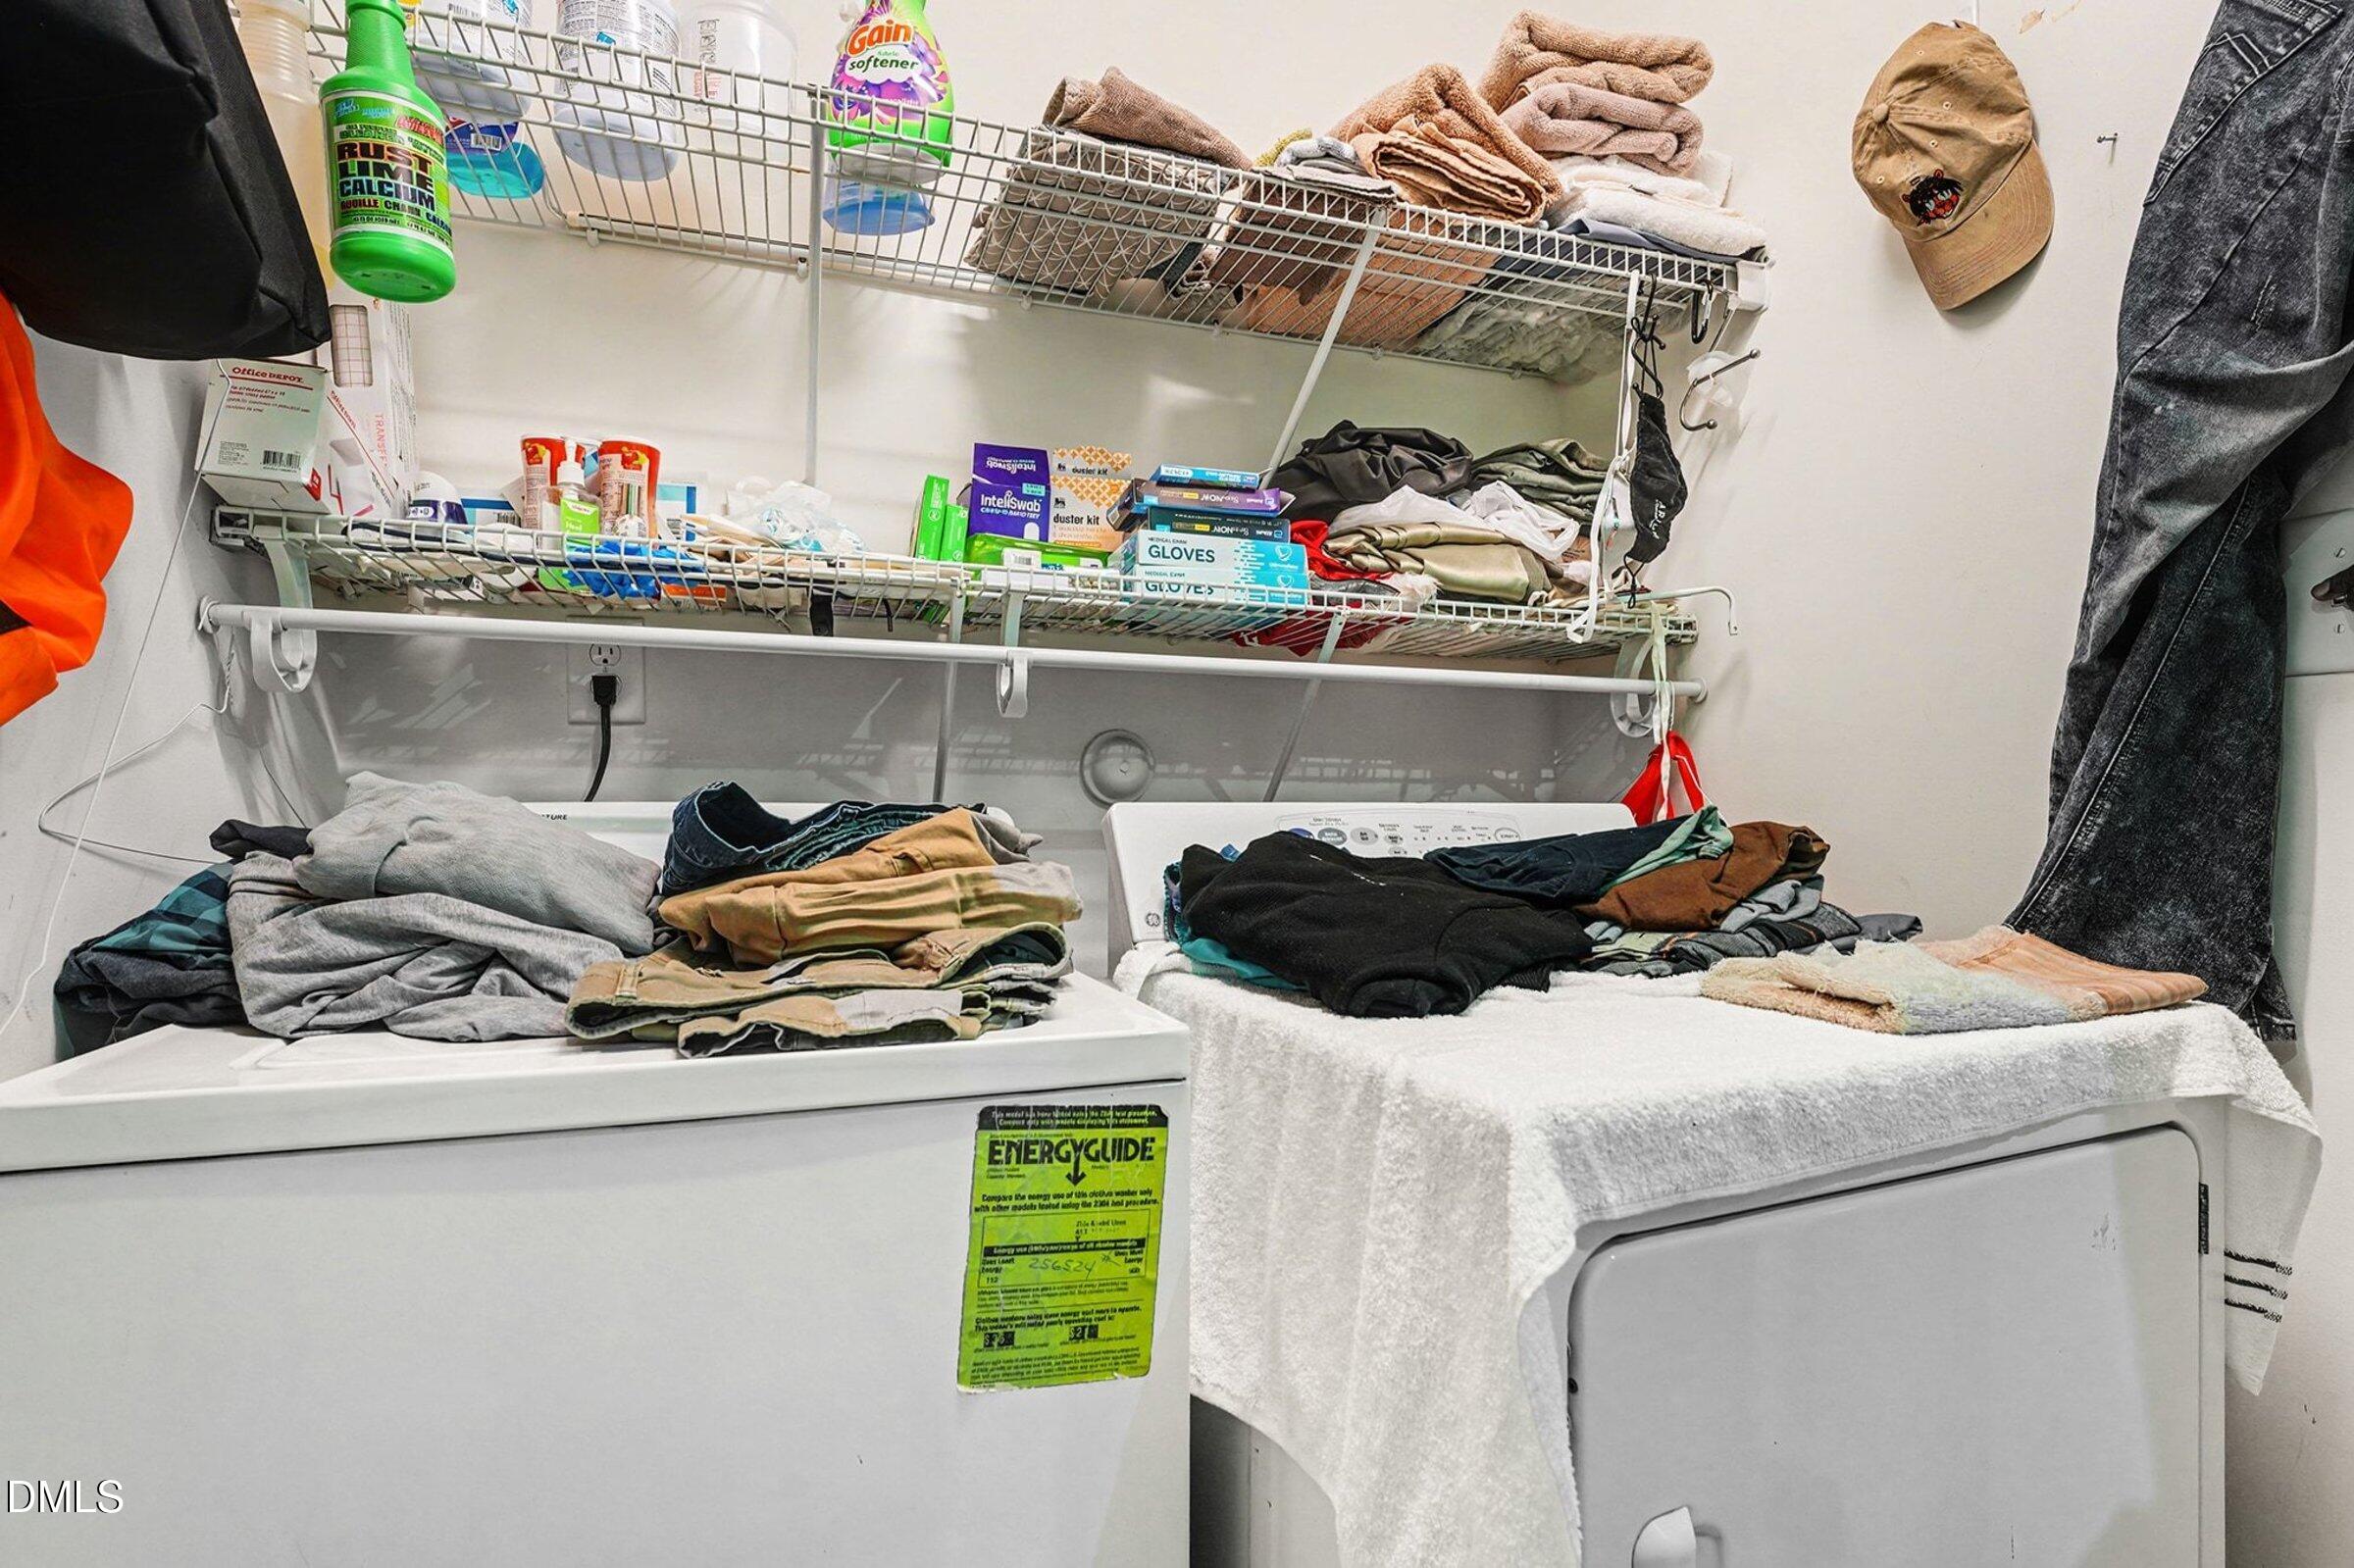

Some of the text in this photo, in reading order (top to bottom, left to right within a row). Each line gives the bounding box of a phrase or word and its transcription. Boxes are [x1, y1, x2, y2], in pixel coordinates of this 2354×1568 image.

[848, 19, 913, 55] Gain
[848, 56, 918, 73] softener
[335, 141, 433, 174] RUST
[337, 160, 434, 193] LIME
[338, 178, 436, 212] CALCIUM
[231, 366, 268, 378] Office
[981, 490, 1042, 513] InteliSwab
[1053, 513, 1100, 526] duster kit
[1148, 544, 1216, 564] GLOVES
[987, 1137, 1156, 1168] ENERGYGUIDE
